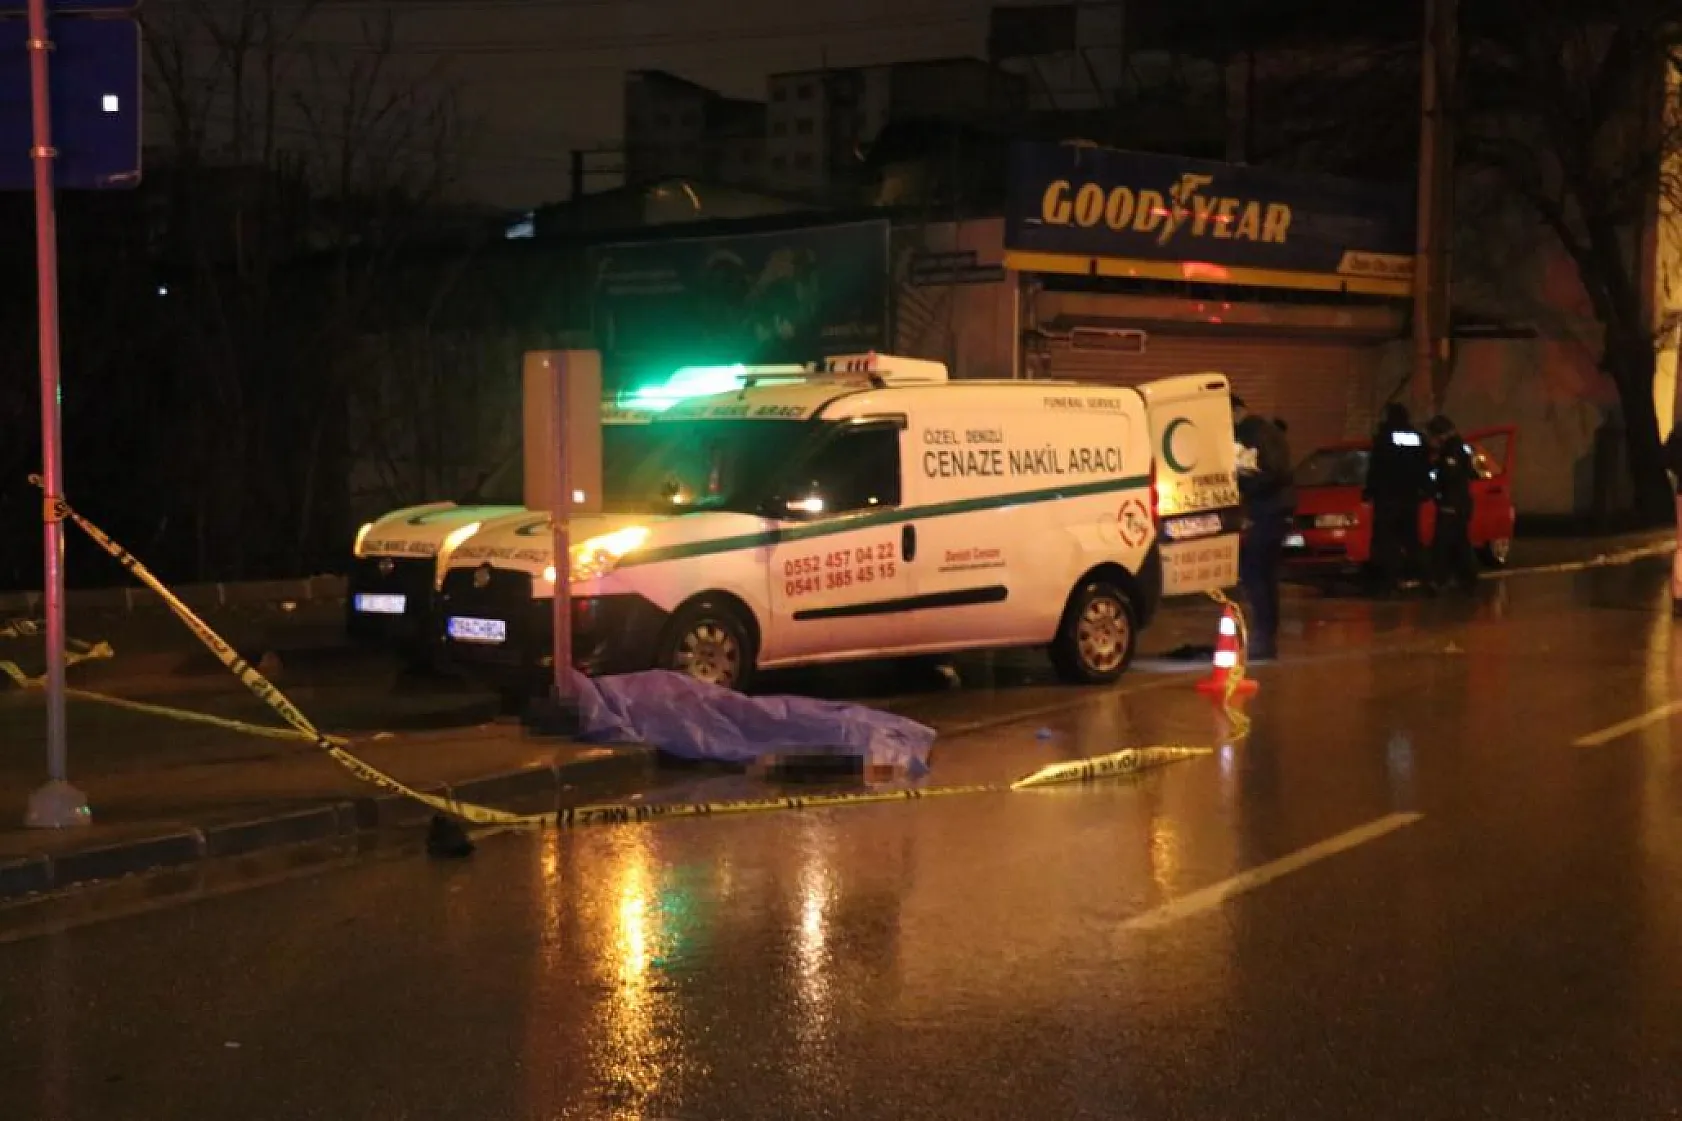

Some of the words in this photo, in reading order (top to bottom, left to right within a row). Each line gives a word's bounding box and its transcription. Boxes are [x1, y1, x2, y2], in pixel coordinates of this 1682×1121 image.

[1042, 174, 1292, 246] GOODYEAR
[923, 428, 960, 445] ÖZEL
[923, 449, 1004, 478] CENAZE
[1008, 442, 1065, 476] NAKİL
[1068, 447, 1123, 474] ARACI
[784, 555, 820, 578] 0552
[825, 549, 851, 569] 457
[855, 546, 874, 564] 04
[876, 542, 896, 560] 22
[785, 576, 820, 597] 0541
[856, 565, 874, 582] 45
[878, 561, 896, 578] 15
